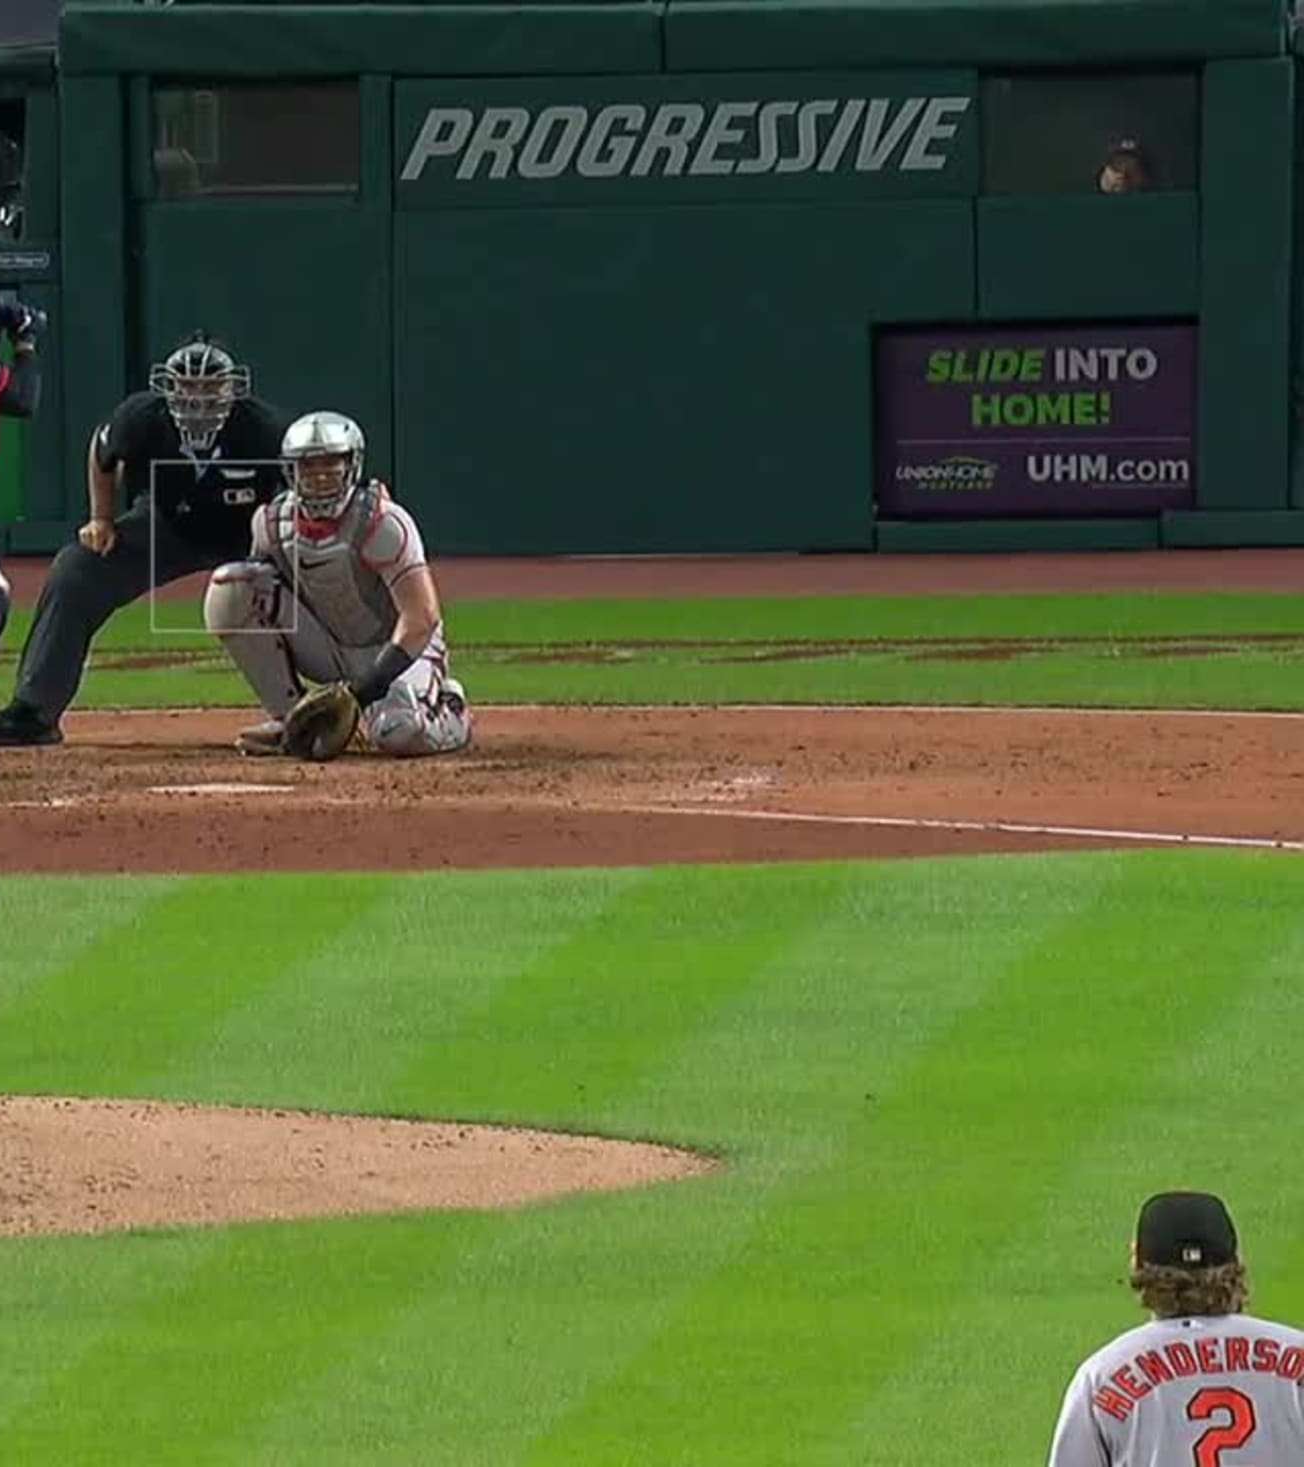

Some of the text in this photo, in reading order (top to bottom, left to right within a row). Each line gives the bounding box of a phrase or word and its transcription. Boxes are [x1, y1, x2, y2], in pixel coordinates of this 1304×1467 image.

[400, 97, 971, 181] PROGRESSIVE
[926, 348, 1157, 383] SLIDE INTO
[972, 392, 1110, 425] HOME!
[1027, 455, 1190, 482] UHM.com
[1092, 1336, 1304, 1422] HENDERSO
[1186, 1386, 1257, 1467] 2
